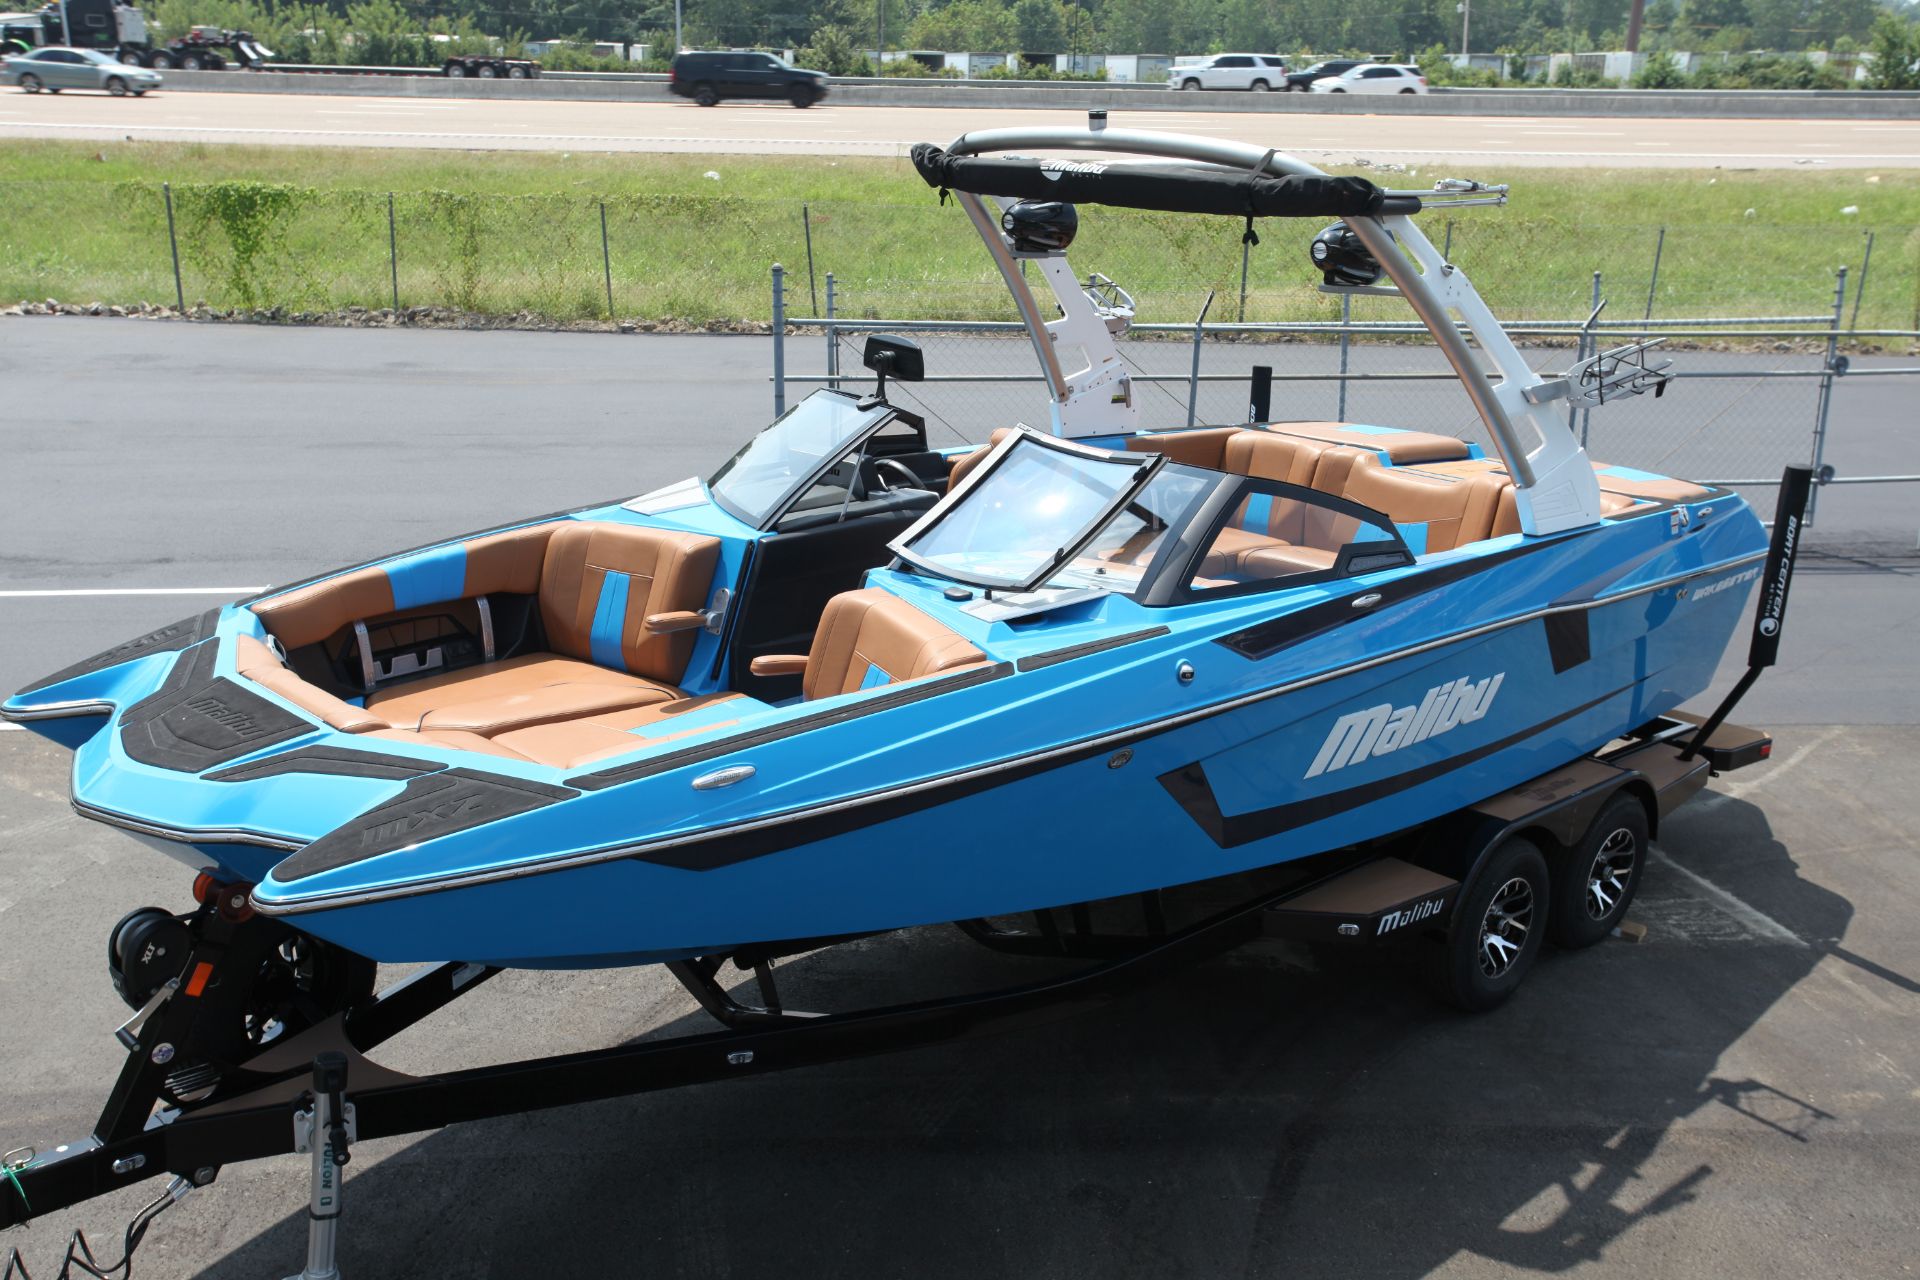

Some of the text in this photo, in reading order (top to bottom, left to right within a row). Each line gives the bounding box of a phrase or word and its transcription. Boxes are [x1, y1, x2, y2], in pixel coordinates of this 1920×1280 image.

[1772, 515, 1798, 618] BOAT CENTER
[184, 697, 264, 737] Malibu
[1303, 672, 1506, 780] Malibu
[360, 793, 484, 848] MXZ
[1377, 898, 1444, 936] Malibu
[141, 942, 156, 964] XLT
[322, 1142, 334, 1189] FULTON
